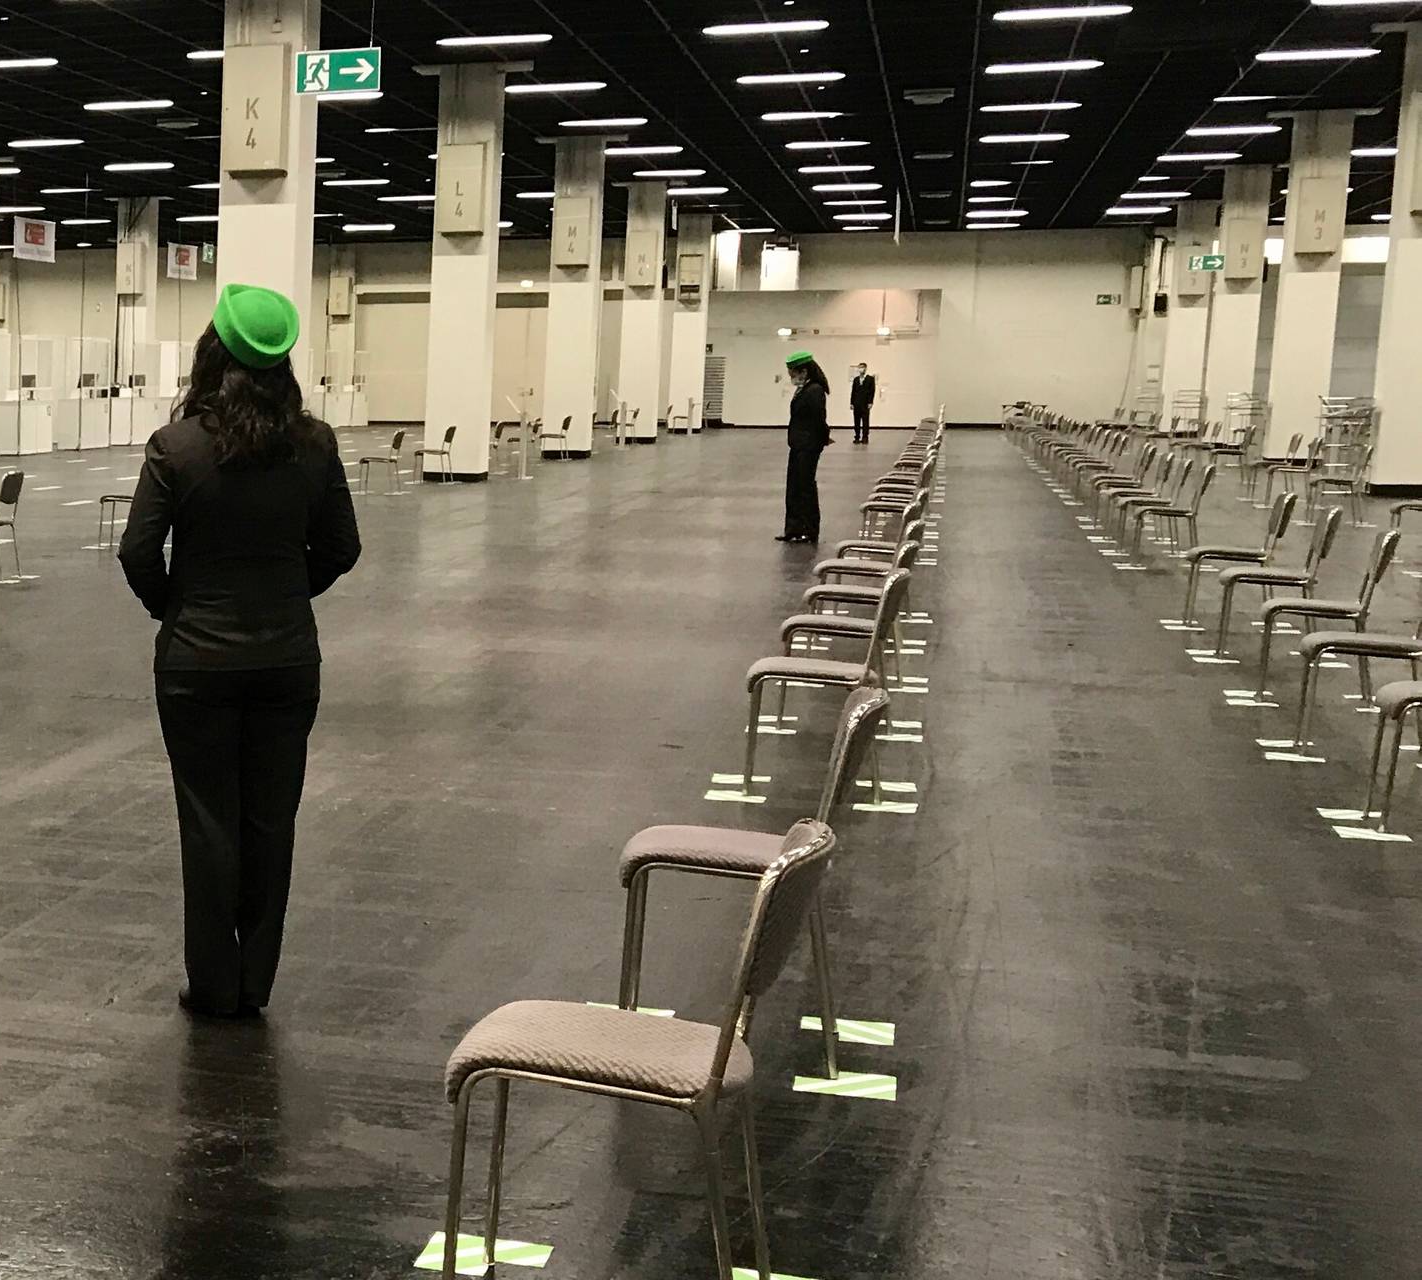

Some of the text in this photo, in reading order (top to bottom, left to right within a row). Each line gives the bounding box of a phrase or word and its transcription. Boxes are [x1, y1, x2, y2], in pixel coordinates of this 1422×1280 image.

[245, 97, 260, 120] K
[245, 127, 257, 149] 4
[456, 181, 464, 197] L
[454, 203, 463, 217] 4
[1315, 209, 1325, 223] M
[568, 226, 577, 238] M
[1313, 227, 1323, 240] 3
